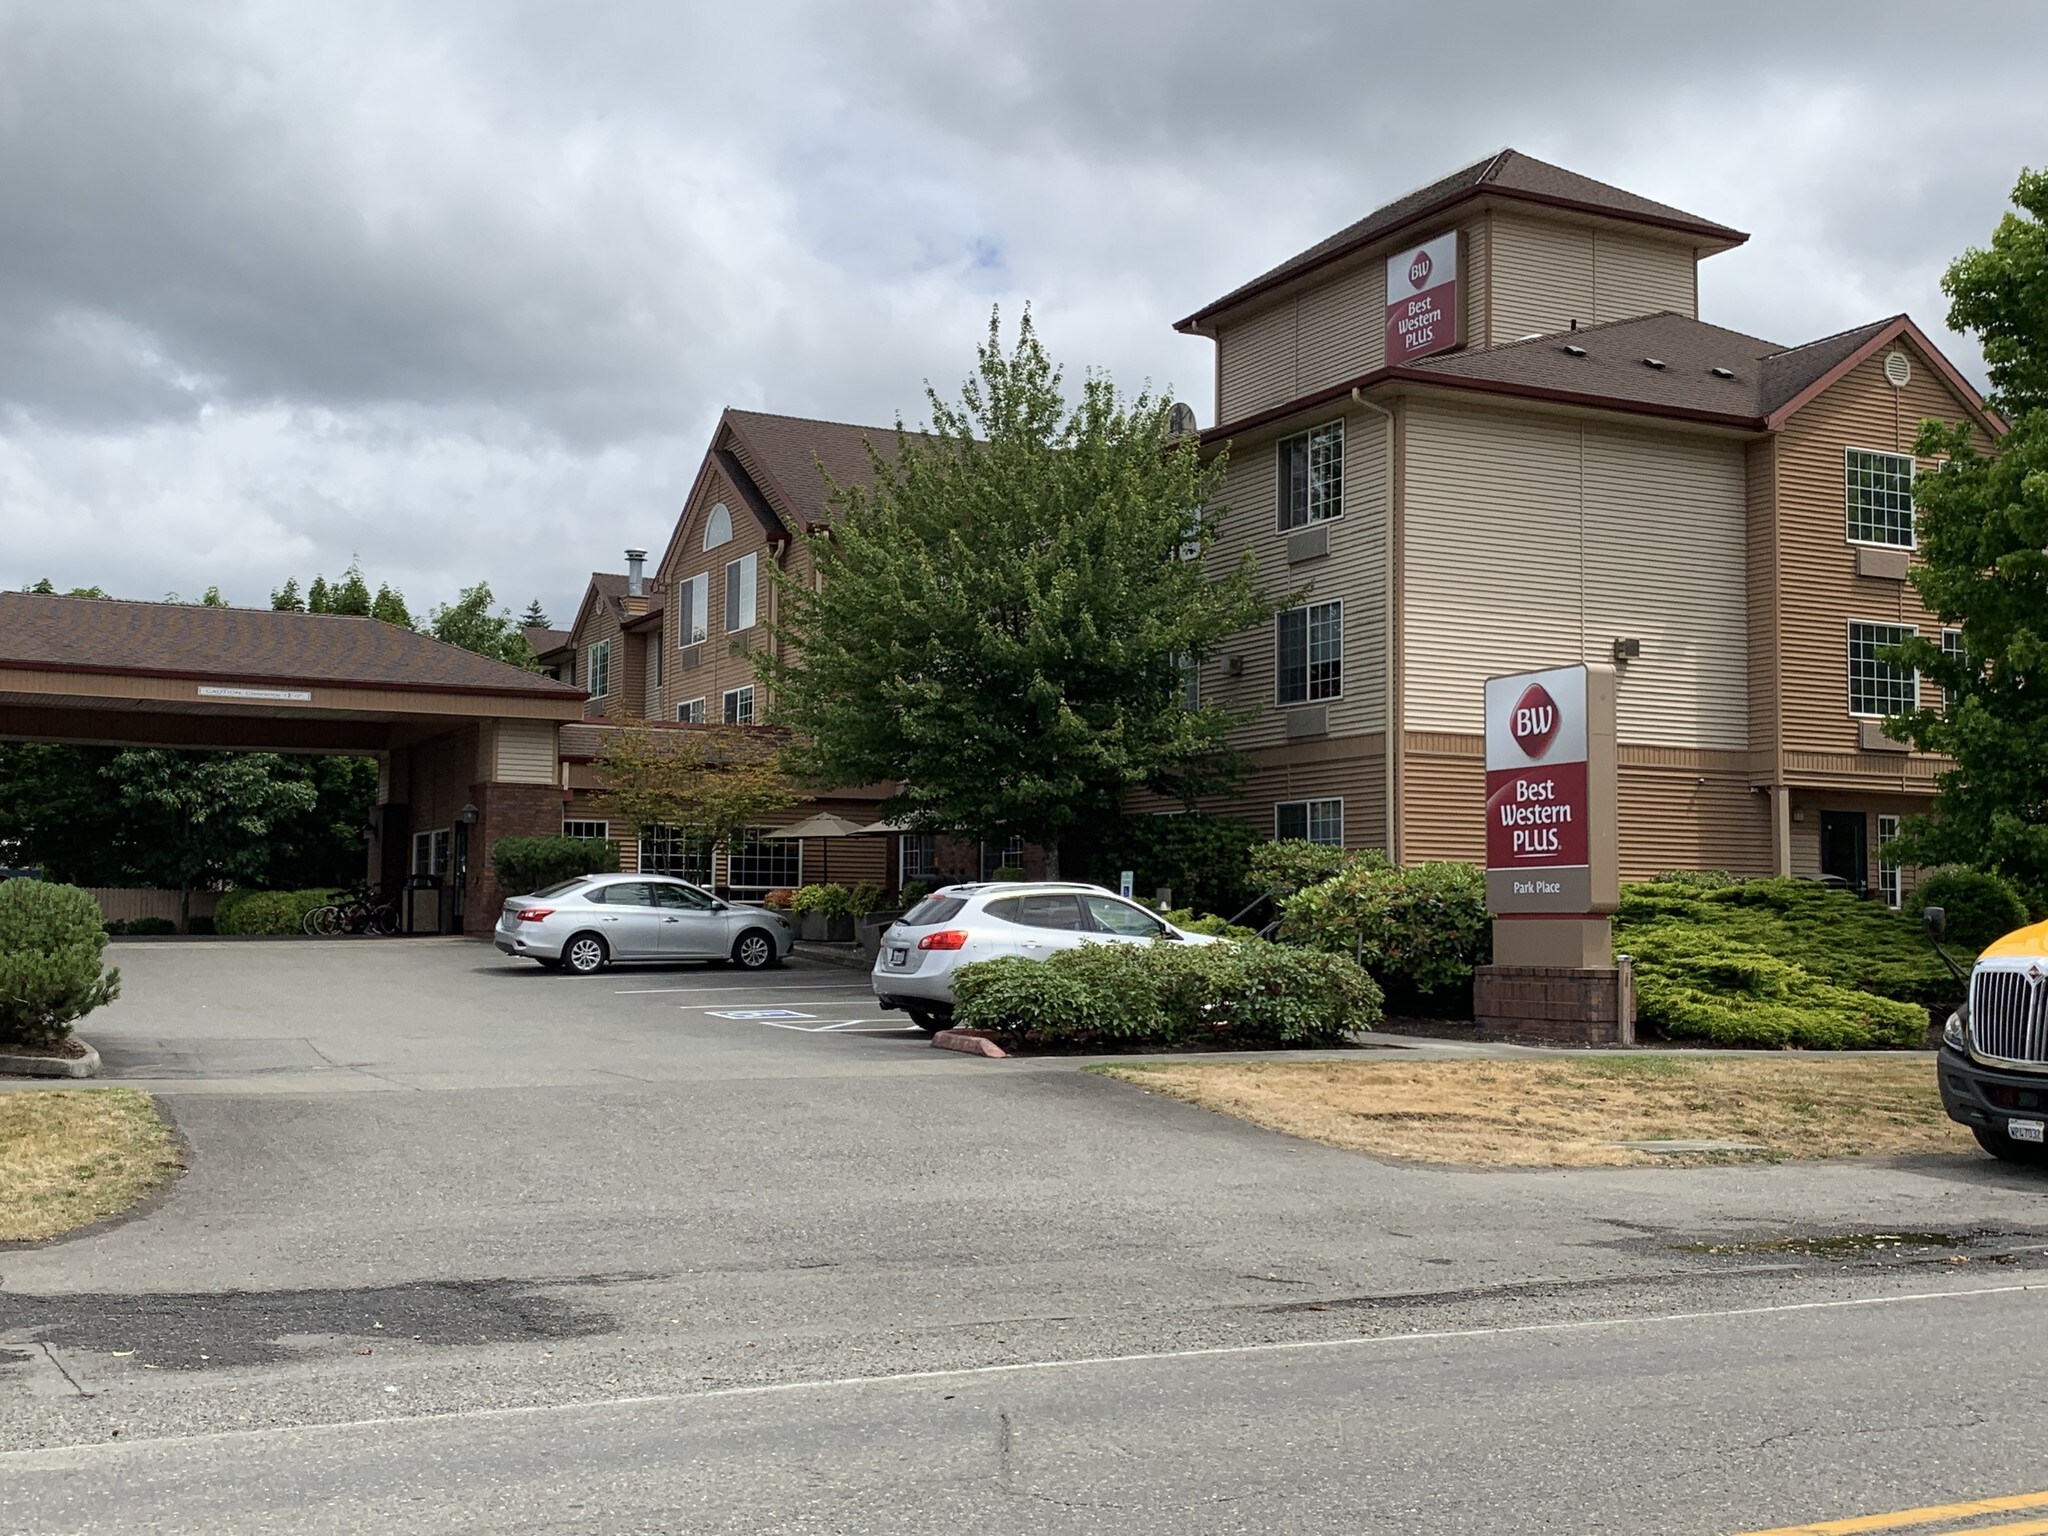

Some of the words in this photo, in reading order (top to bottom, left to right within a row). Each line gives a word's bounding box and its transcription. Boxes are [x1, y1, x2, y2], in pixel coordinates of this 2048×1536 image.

[1411, 261, 1430, 280] BW
[1408, 297, 1432, 316] Best
[1398, 309, 1441, 335] Western
[1405, 326, 1433, 348] PLUS
[1517, 705, 1552, 736] BW
[1516, 780, 1555, 802] Best
[1500, 804, 1572, 826] Western
[1513, 828, 1558, 852] PLUS
[1514, 881, 1534, 893] Park
[1536, 881, 1560, 893] Place
